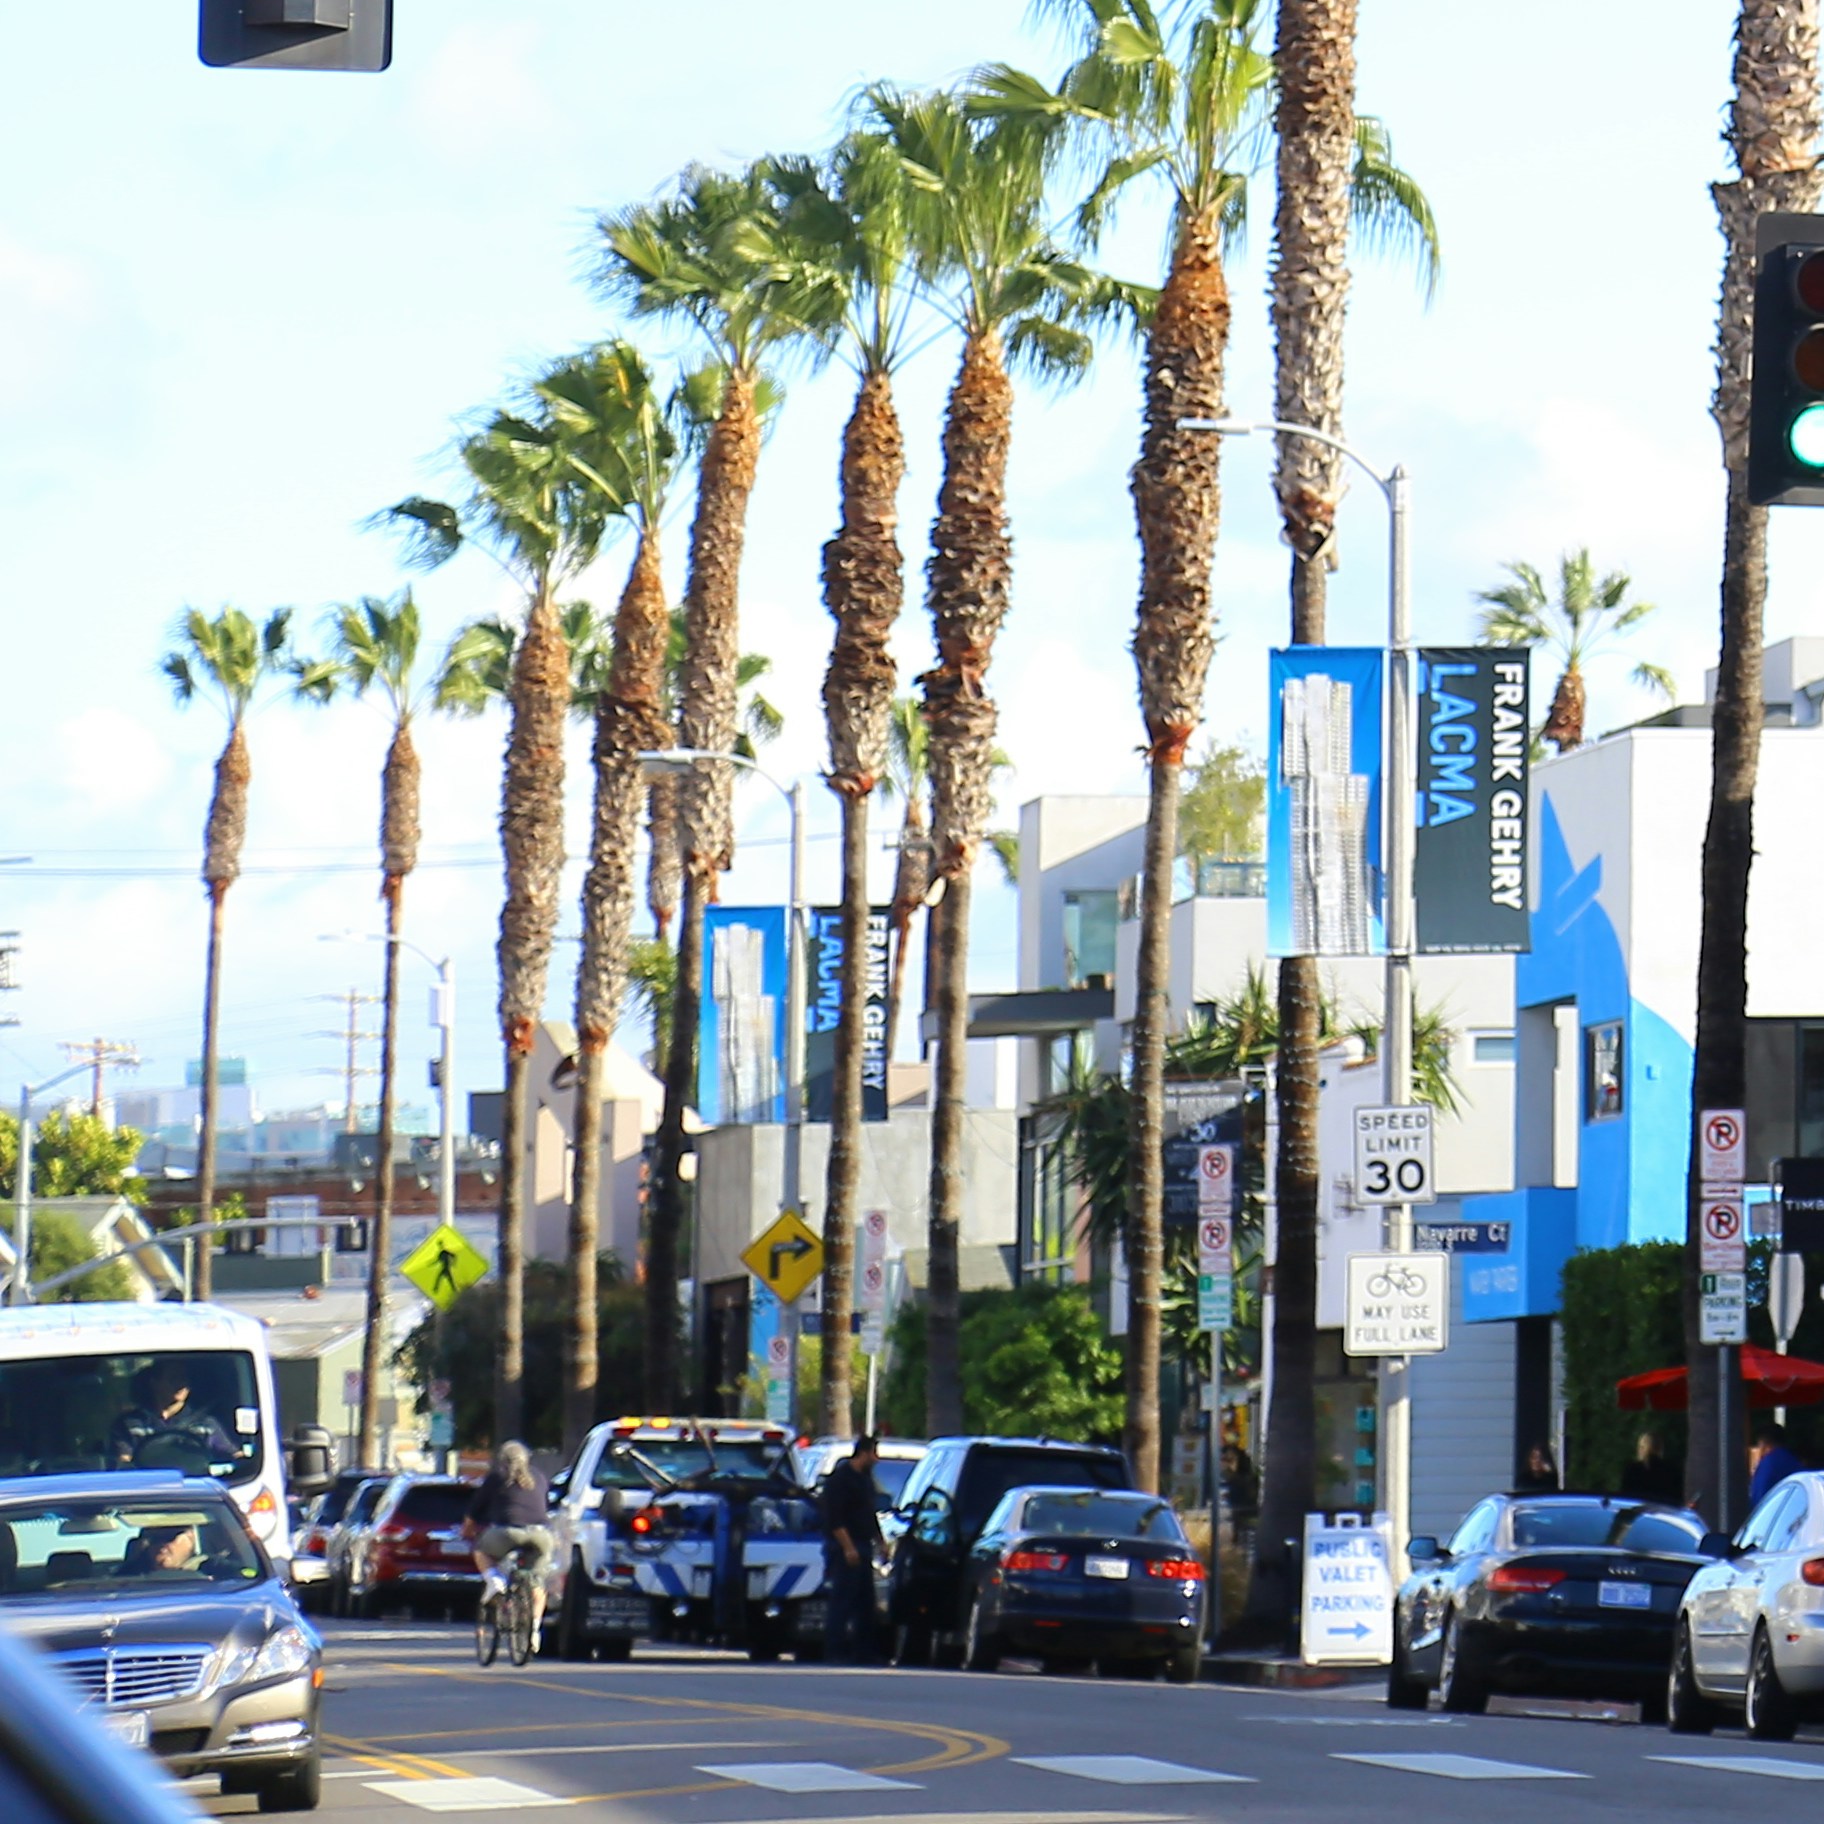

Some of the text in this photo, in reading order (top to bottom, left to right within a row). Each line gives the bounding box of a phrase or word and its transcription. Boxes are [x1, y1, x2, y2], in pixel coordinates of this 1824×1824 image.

[1491, 661, 1525, 783] FRANK
[1428, 663, 1478, 828] LACMA
[1489, 789, 1523, 911] GEHRY
[862, 1004, 887, 1090] GEHRY
[1358, 1114, 1429, 1131] SPEED
[1365, 1136, 1422, 1153] LIMIT
[1365, 1159, 1425, 1194] 30
[1416, 1224, 1507, 1243] Navarre Ct
[1362, 1304, 1431, 1319] MAY USE
[1354, 1327, 1438, 1342] FULL LANE
[1313, 1541, 1382, 1558] PUBLIC
[1319, 1565, 1376, 1583] VALET
[1310, 1594, 1385, 1612] PARKING
